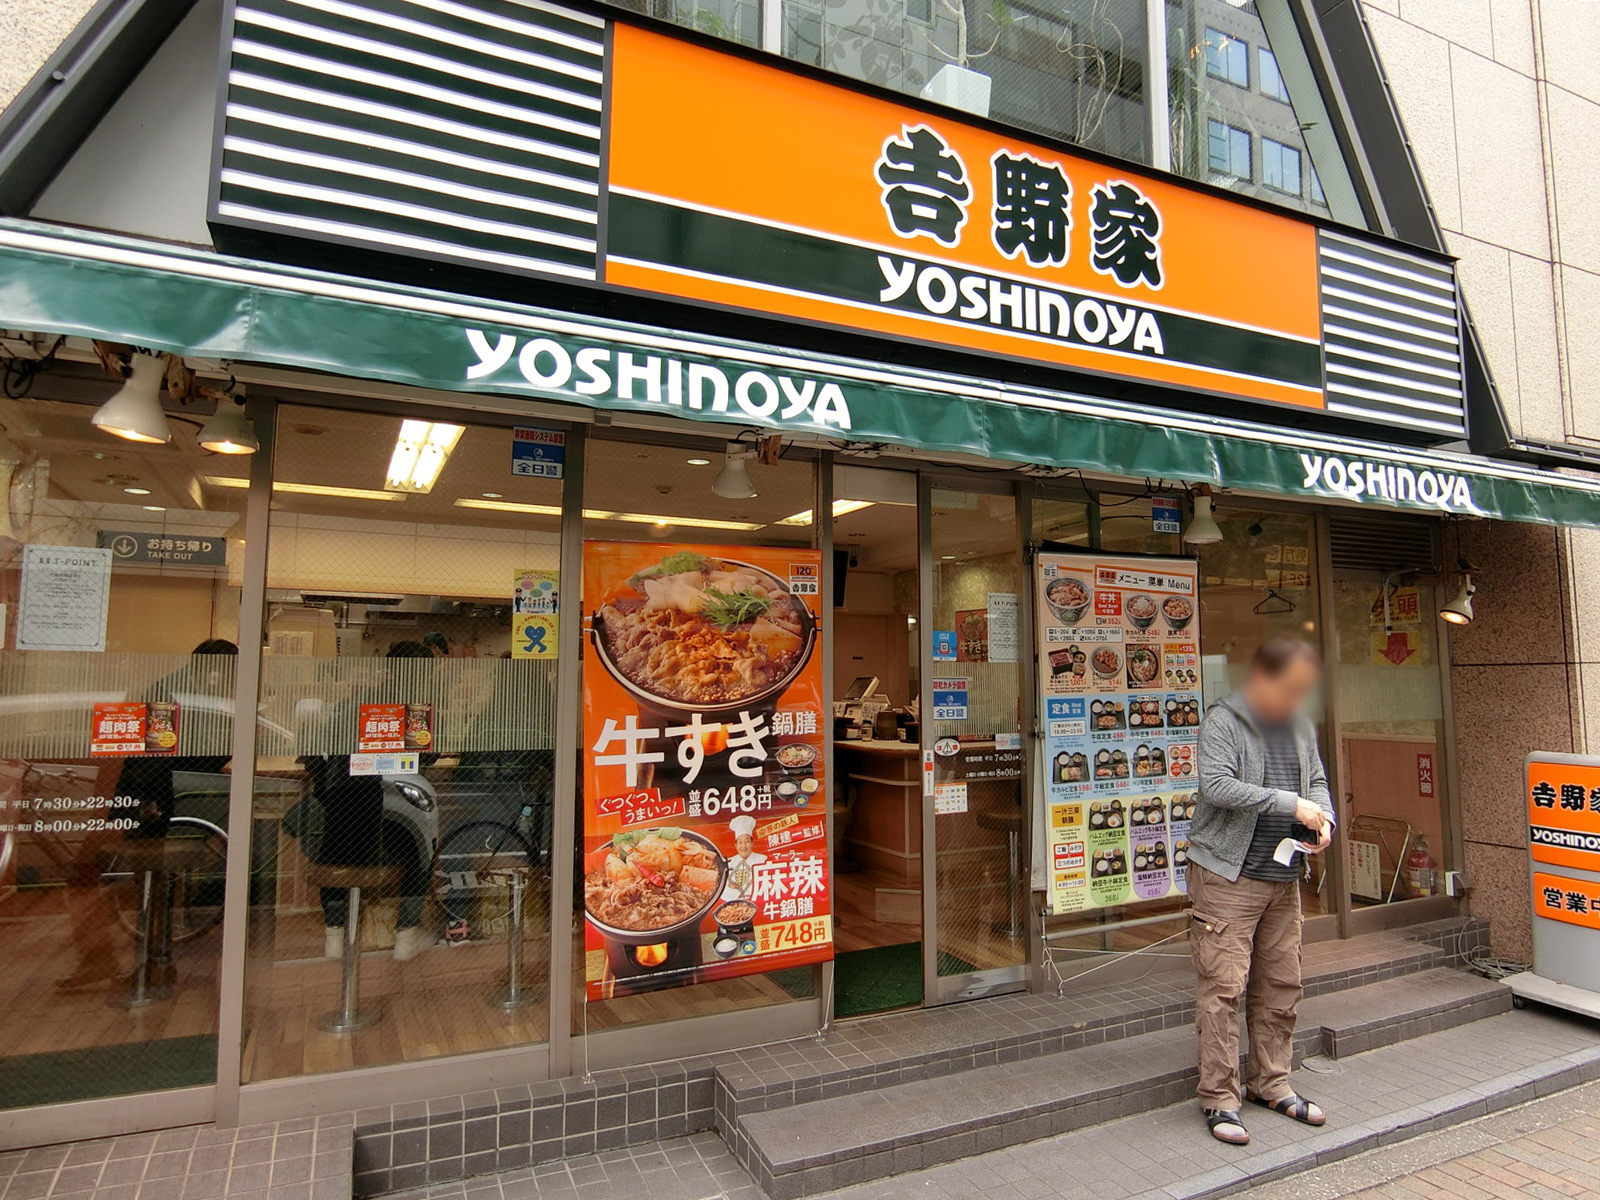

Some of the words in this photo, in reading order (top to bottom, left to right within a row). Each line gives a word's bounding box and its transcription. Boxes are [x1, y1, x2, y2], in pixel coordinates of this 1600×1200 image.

[874, 123, 1165, 290] 吉野家
[877, 255, 1164, 355] YOSHINOYA
[464, 328, 852, 429] YOSHINOYA
[1300, 453, 1471, 506] YOSHINOYA
[148, 538, 212, 552] お持ち帰り
[148, 551, 171, 559] TAKE
[1118, 574, 1146, 585] メニュー
[1168, 579, 1190, 591] Menu
[1052, 703, 1070, 715] 定食
[98, 720, 141, 734] 超肉祭
[365, 721, 400, 733] 超肉祭
[592, 711, 769, 787] 牛すき
[771, 711, 816, 736] 鍋膳
[1419, 757, 1432, 794] 消火器
[773, 849, 803, 861] マーラー
[751, 855, 826, 902] 麻辣
[763, 896, 814, 920] 牛鍋膳
